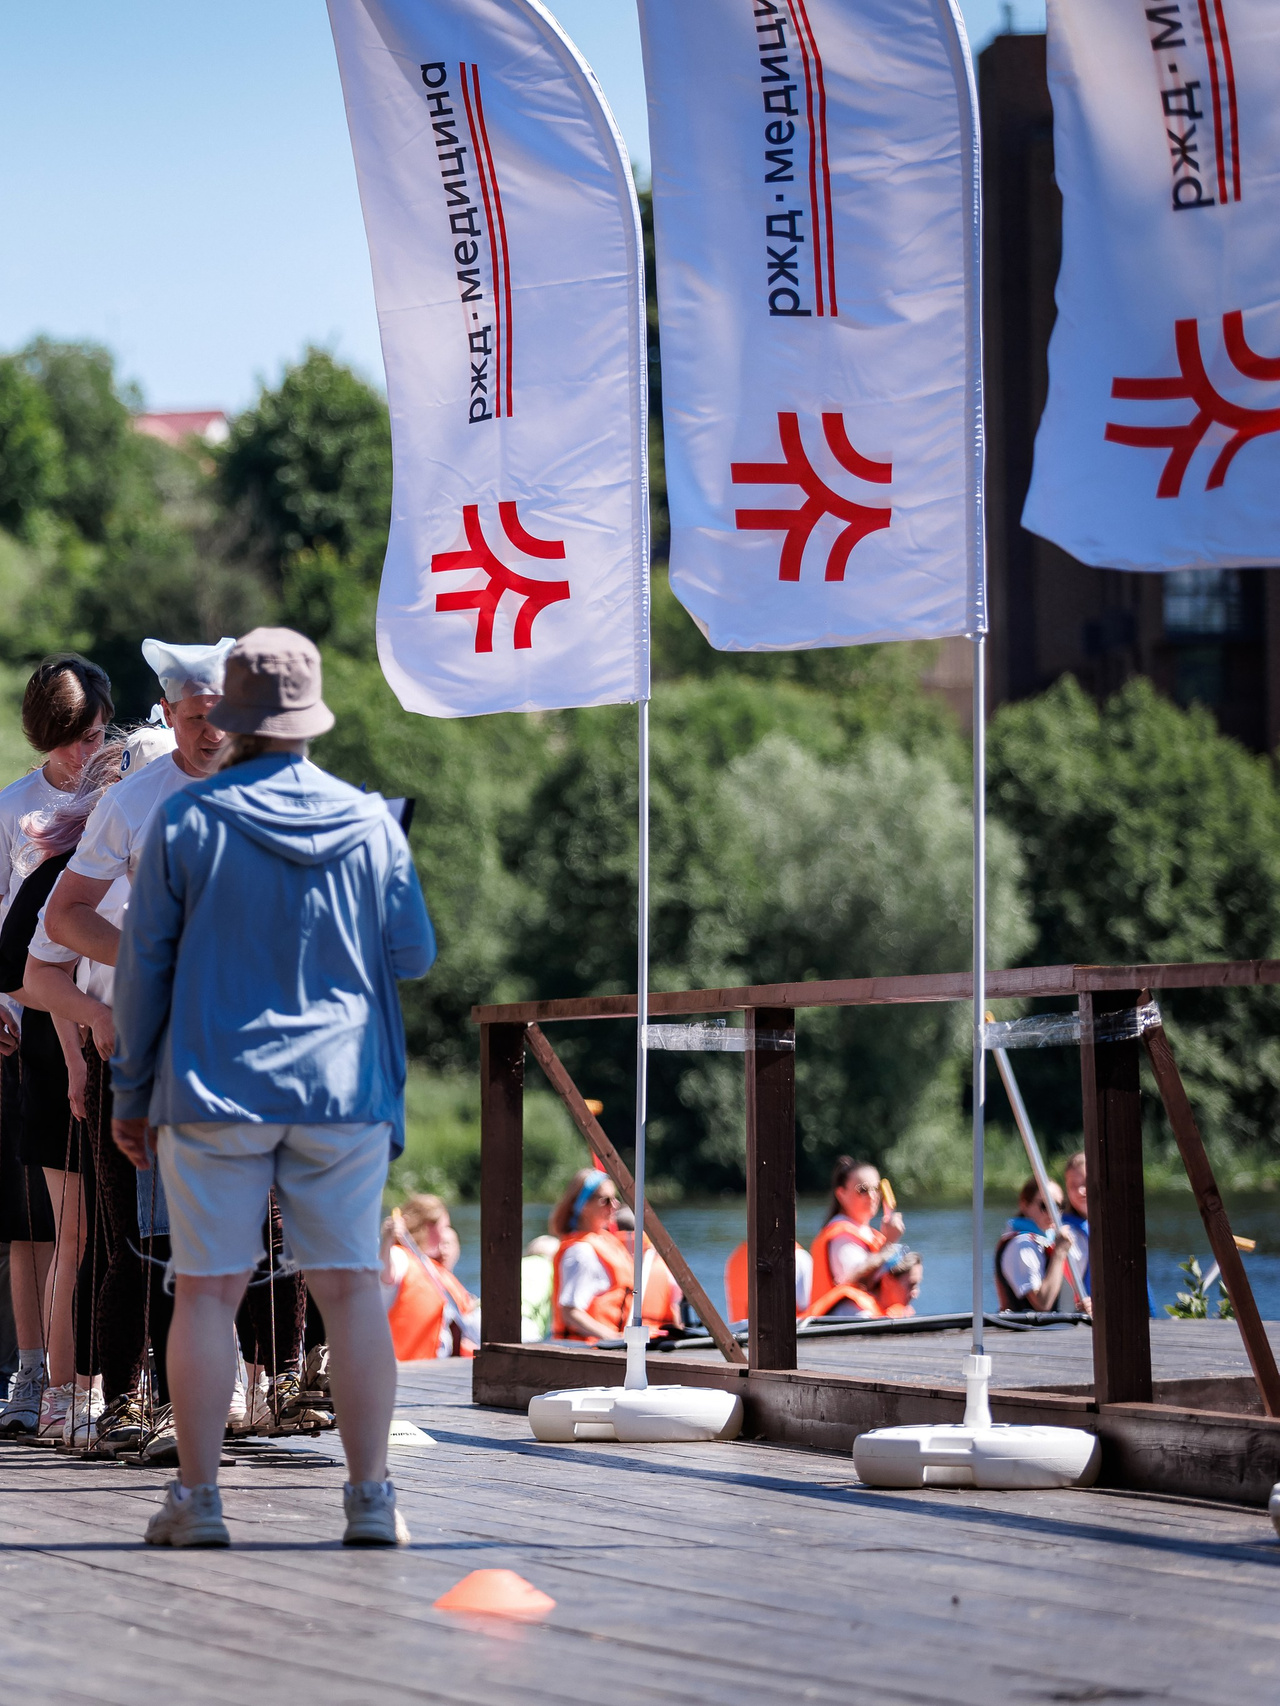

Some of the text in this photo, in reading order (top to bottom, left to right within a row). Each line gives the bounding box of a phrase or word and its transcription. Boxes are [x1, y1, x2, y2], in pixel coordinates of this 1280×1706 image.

[1160, 81, 1216, 211] ржд
[420, 61, 493, 425] ржд медицина
[765, 209, 812, 317] ржд
